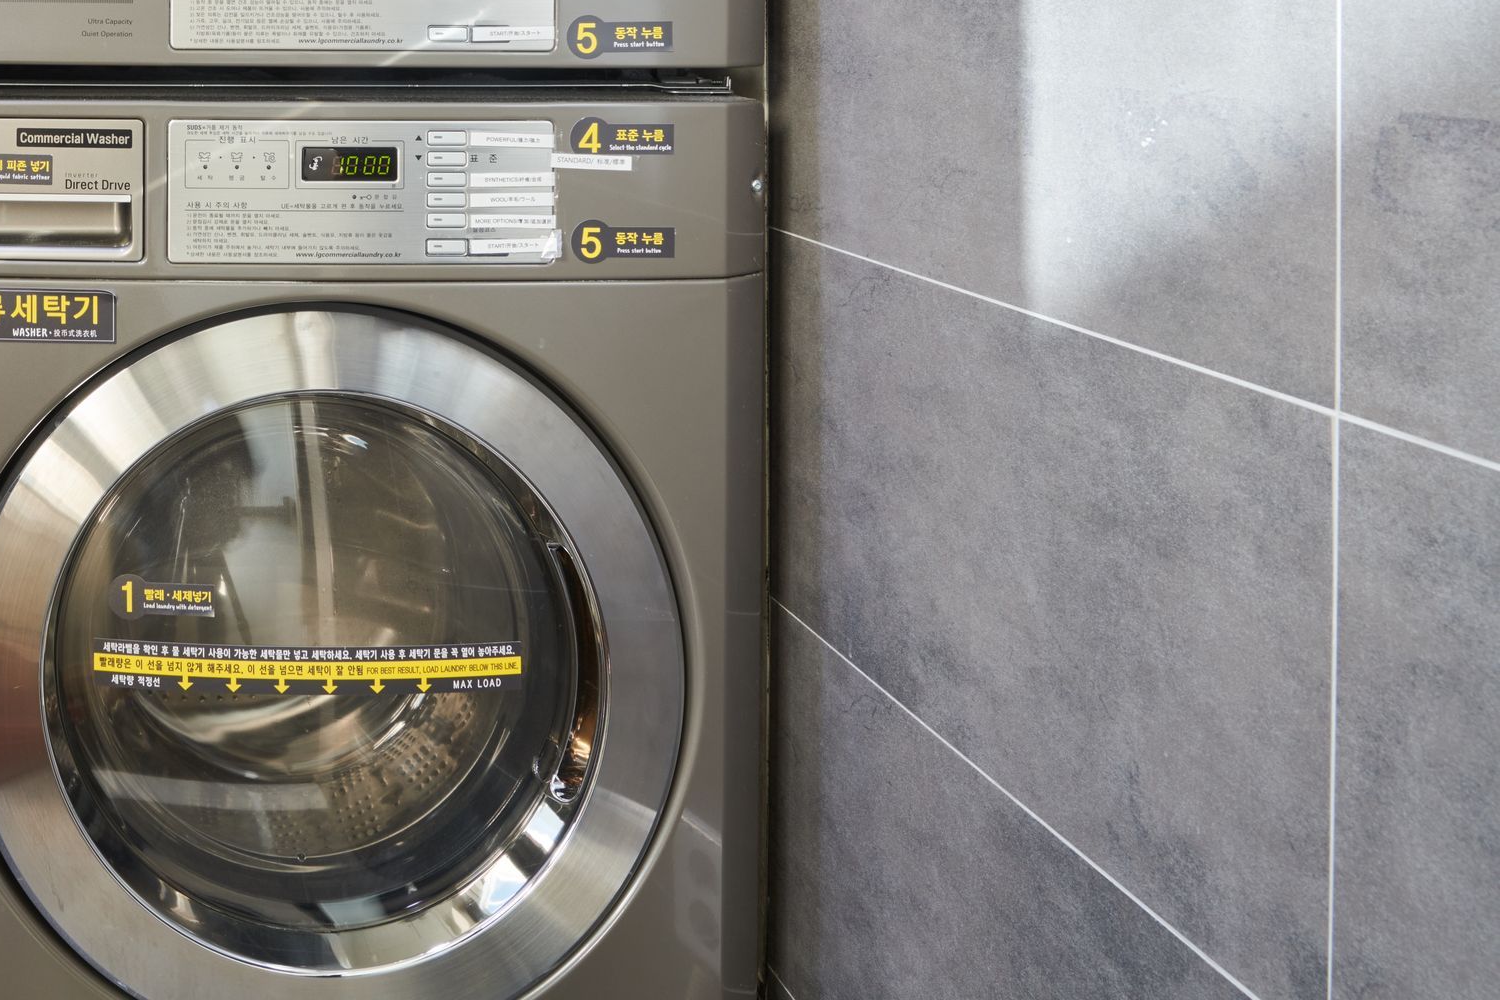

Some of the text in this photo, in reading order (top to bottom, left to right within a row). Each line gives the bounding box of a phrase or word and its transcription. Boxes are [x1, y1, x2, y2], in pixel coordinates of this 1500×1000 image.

[101, 31, 132, 39] Operation
[577, 23, 597, 53] 5
[615, 27, 663, 39] 동작 누름
[21, 132, 129, 144] Commercial Washer
[578, 122, 601, 153] 4
[616, 130, 664, 141] 표준 누름
[31, 161, 49, 172] 넣기
[65, 179, 130, 190] Direct Drive
[581, 227, 601, 258] 5
[615, 233, 664, 244] 동작 누름
[12, 328, 47, 337] WASHER
[122, 581, 132, 612] 1
[144, 589, 164, 601] 빨래
[99, 657, 131, 668] 빨래량은
[136, 659, 143, 669] 이
[148, 660, 162, 670] 선을
[167, 661, 182, 671] 넘지
[187, 662, 202, 672] 않게
[248, 665, 254, 674] 이
[259, 665, 275, 675] 선을
[280, 665, 303, 675] 넘으면
[308, 666, 331, 675] 세탁이
[336, 666, 343, 675] 잘
[348, 666, 363, 675] 안됨
[381, 666, 395, 674] BEST
[398, 665, 421, 674] RESULT,
[423, 665, 439, 673] LOAD
[441, 664, 467, 672] LAUNDRY
[505, 662, 518, 670] LINE.
[112, 675, 160, 687] 세탁량 적정선
[453, 679, 501, 689] MAX LOAD
